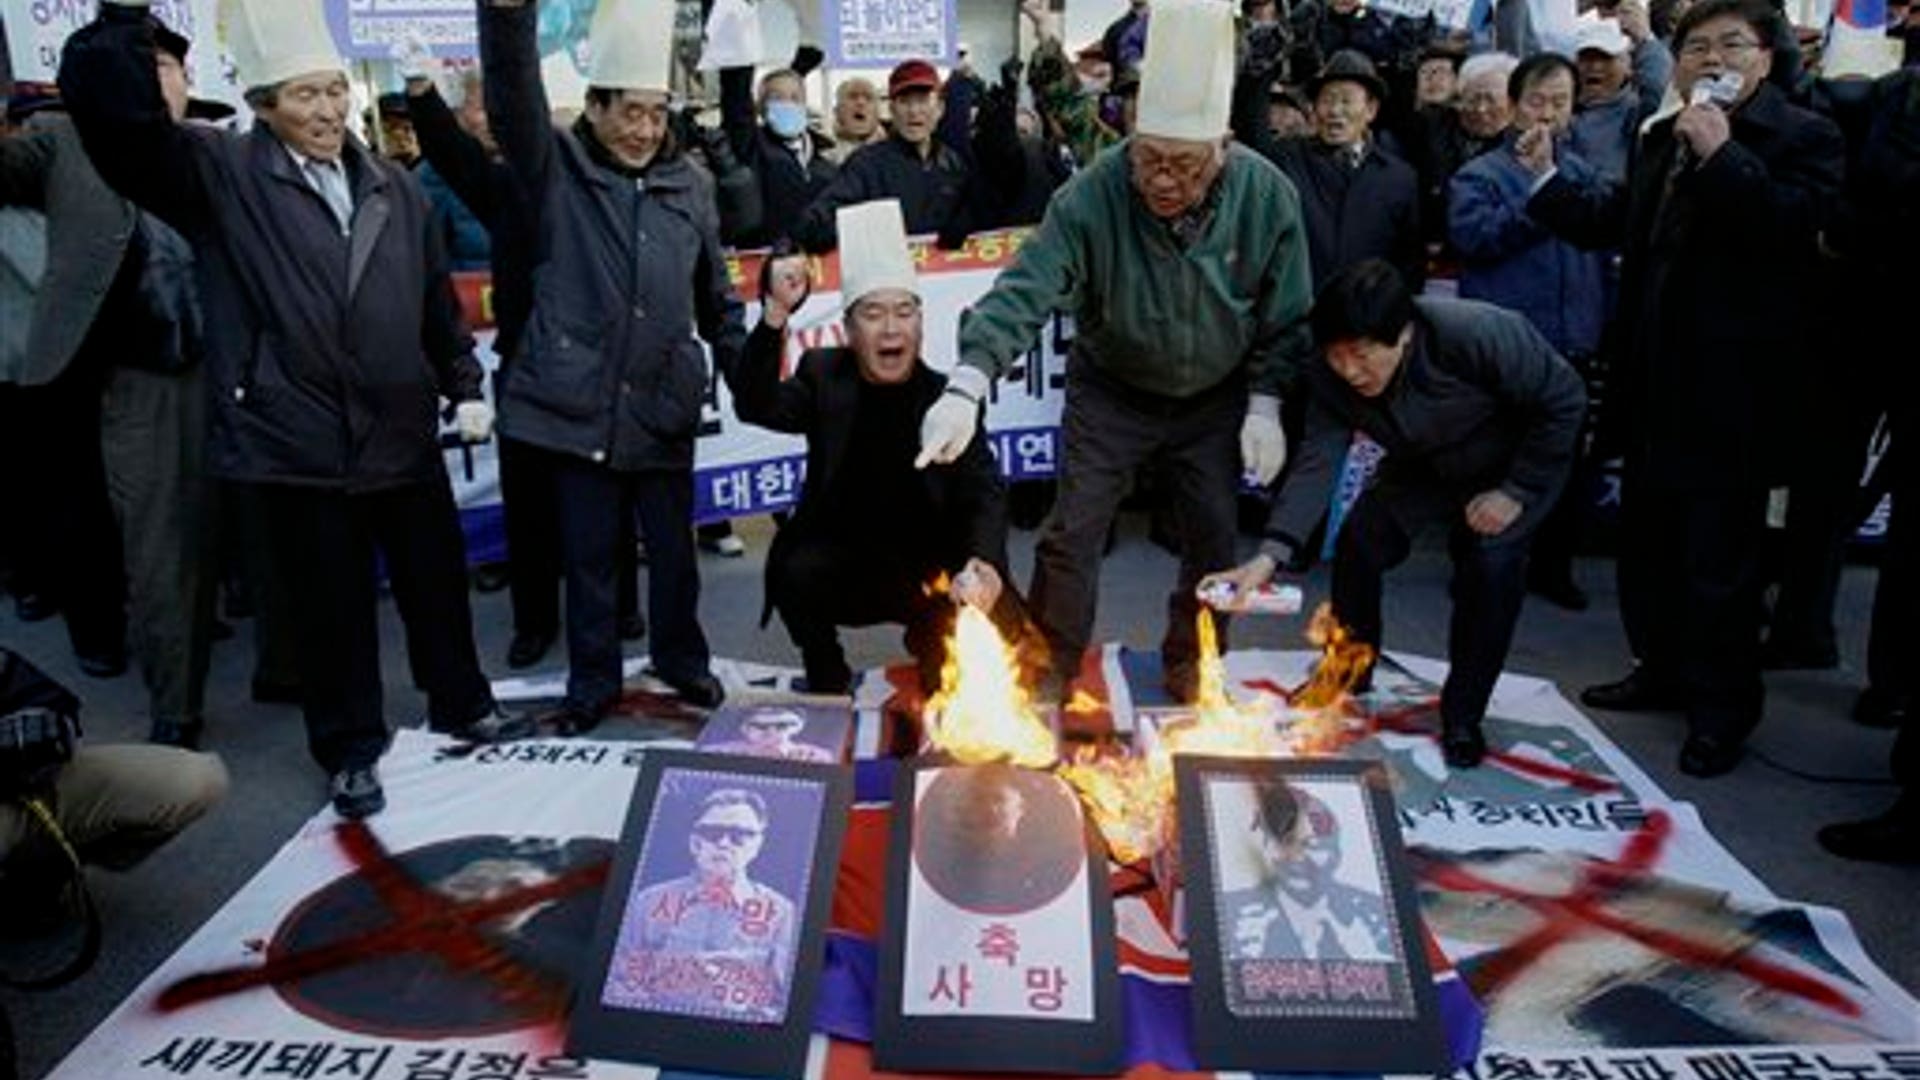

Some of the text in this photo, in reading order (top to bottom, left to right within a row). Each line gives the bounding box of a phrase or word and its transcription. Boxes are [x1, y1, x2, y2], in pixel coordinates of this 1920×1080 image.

[712, 459, 807, 509] 대한
[432, 744, 608, 765] 신돼지
[742, 898, 777, 938] 망
[976, 921, 1021, 968] 축
[929, 963, 1069, 1012] 사 망
[140, 1036, 395, 1080] 새끼돼지
